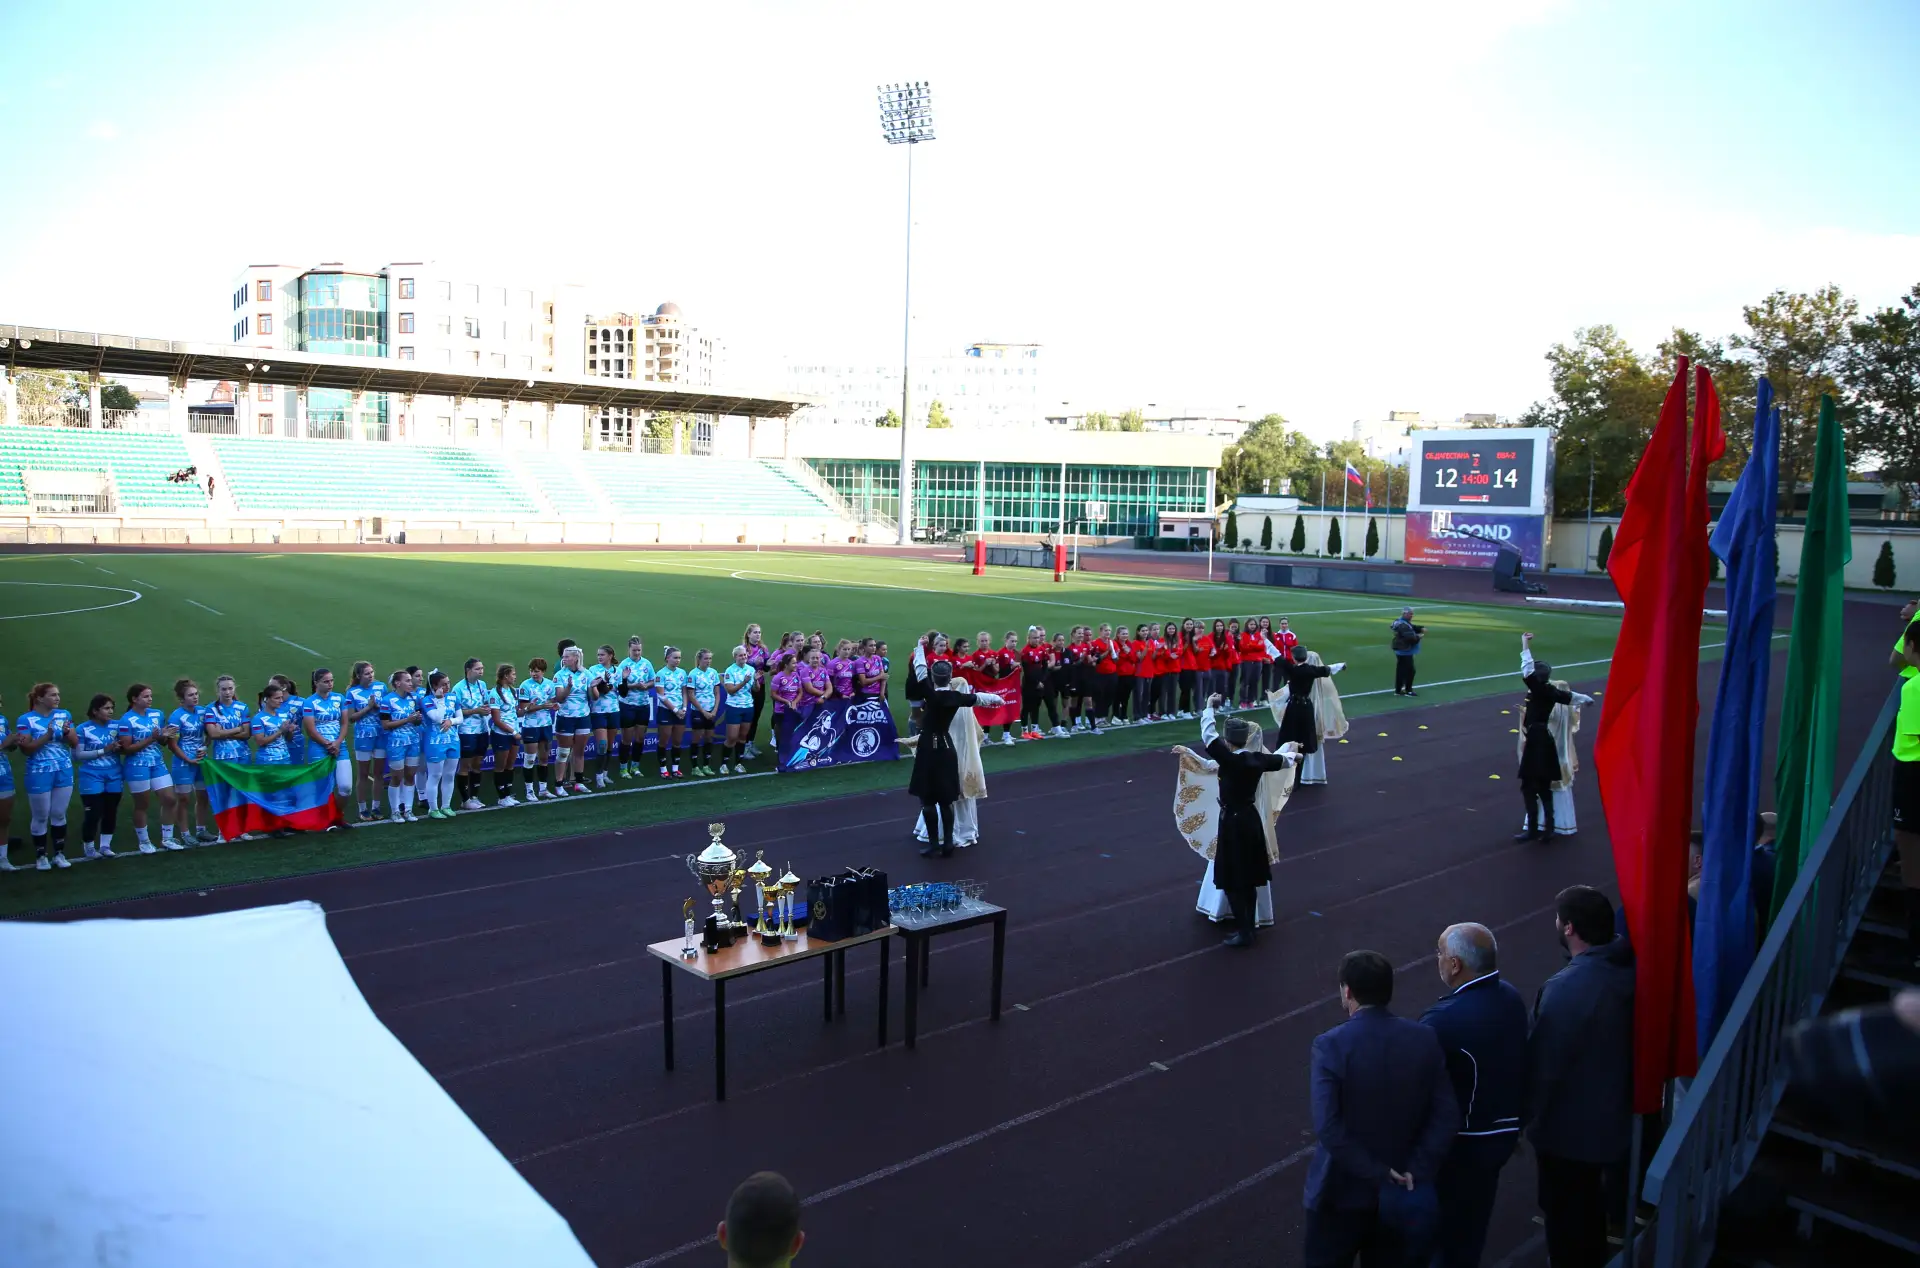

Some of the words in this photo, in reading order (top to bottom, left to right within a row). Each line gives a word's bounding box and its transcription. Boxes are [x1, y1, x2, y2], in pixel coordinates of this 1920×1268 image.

[1472, 458, 1480, 466] 2
[1435, 468, 1458, 488] 12
[1461, 474, 1489, 484] 14:00
[1493, 468, 1518, 488] 14
